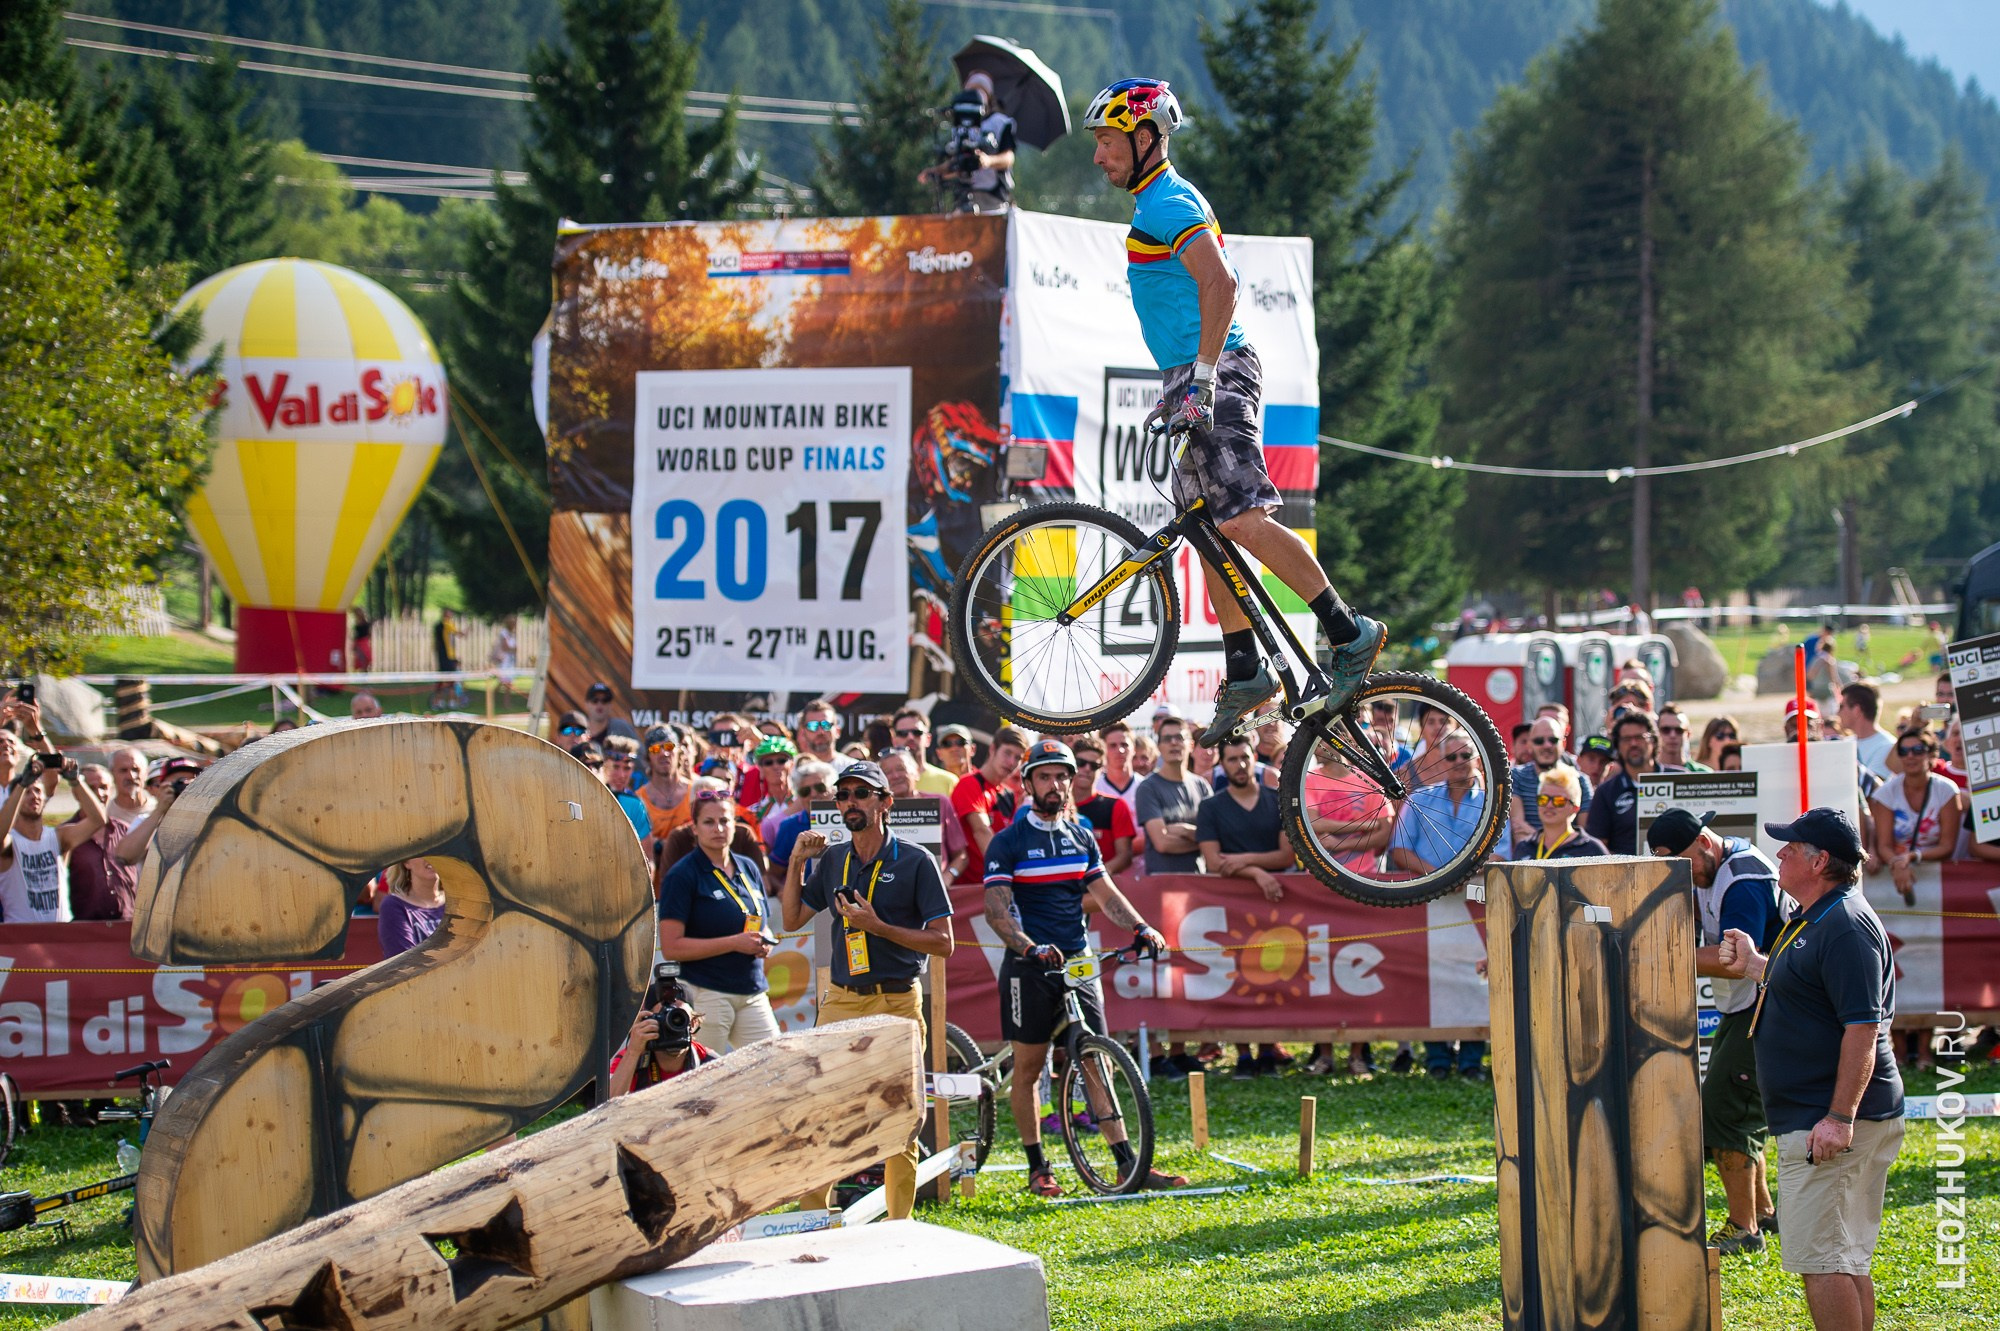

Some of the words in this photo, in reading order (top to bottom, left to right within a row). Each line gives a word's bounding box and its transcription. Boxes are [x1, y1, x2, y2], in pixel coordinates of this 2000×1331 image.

[712, 256, 737, 268] UCI
[244, 372, 321, 433] Val
[328, 392, 359, 425] di
[657, 405, 694, 431] UCI
[703, 405, 824, 430] MOUNTAIN
[835, 403, 888, 429] BIKE
[656, 447, 736, 472] WORLD
[747, 447, 793, 471] CUP
[803, 446, 885, 471] FINALS
[1083, 568, 1127, 607] mybike
[656, 626, 716, 659] 25TH
[746, 626, 807, 659] 27TH
[815, 629, 885, 660] AUG.
[1955, 651, 1979, 666] UCI
[1974, 724, 1980, 735] 6
[1645, 786, 1670, 797] UCI
[1078, 965, 1084, 977] 5
[82, 995, 145, 1055] di
